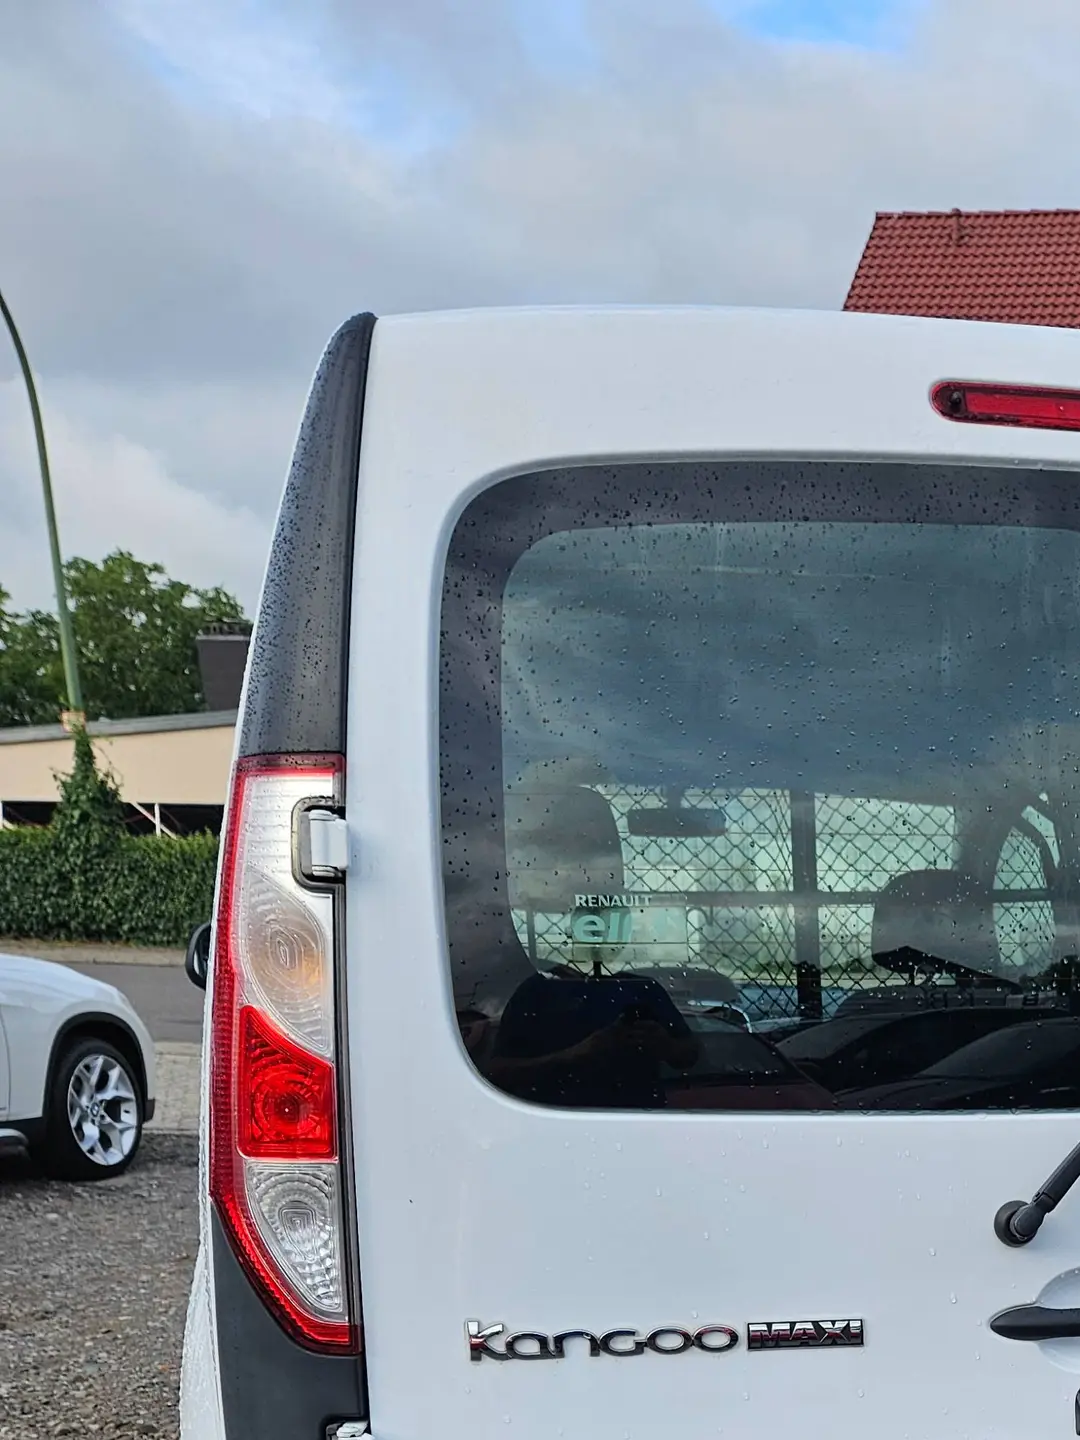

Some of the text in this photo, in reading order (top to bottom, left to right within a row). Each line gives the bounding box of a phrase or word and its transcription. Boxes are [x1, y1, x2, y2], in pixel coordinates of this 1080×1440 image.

[574, 894, 653, 908] RENAULT
[465, 1318, 863, 1362] Kangoo MAXI
